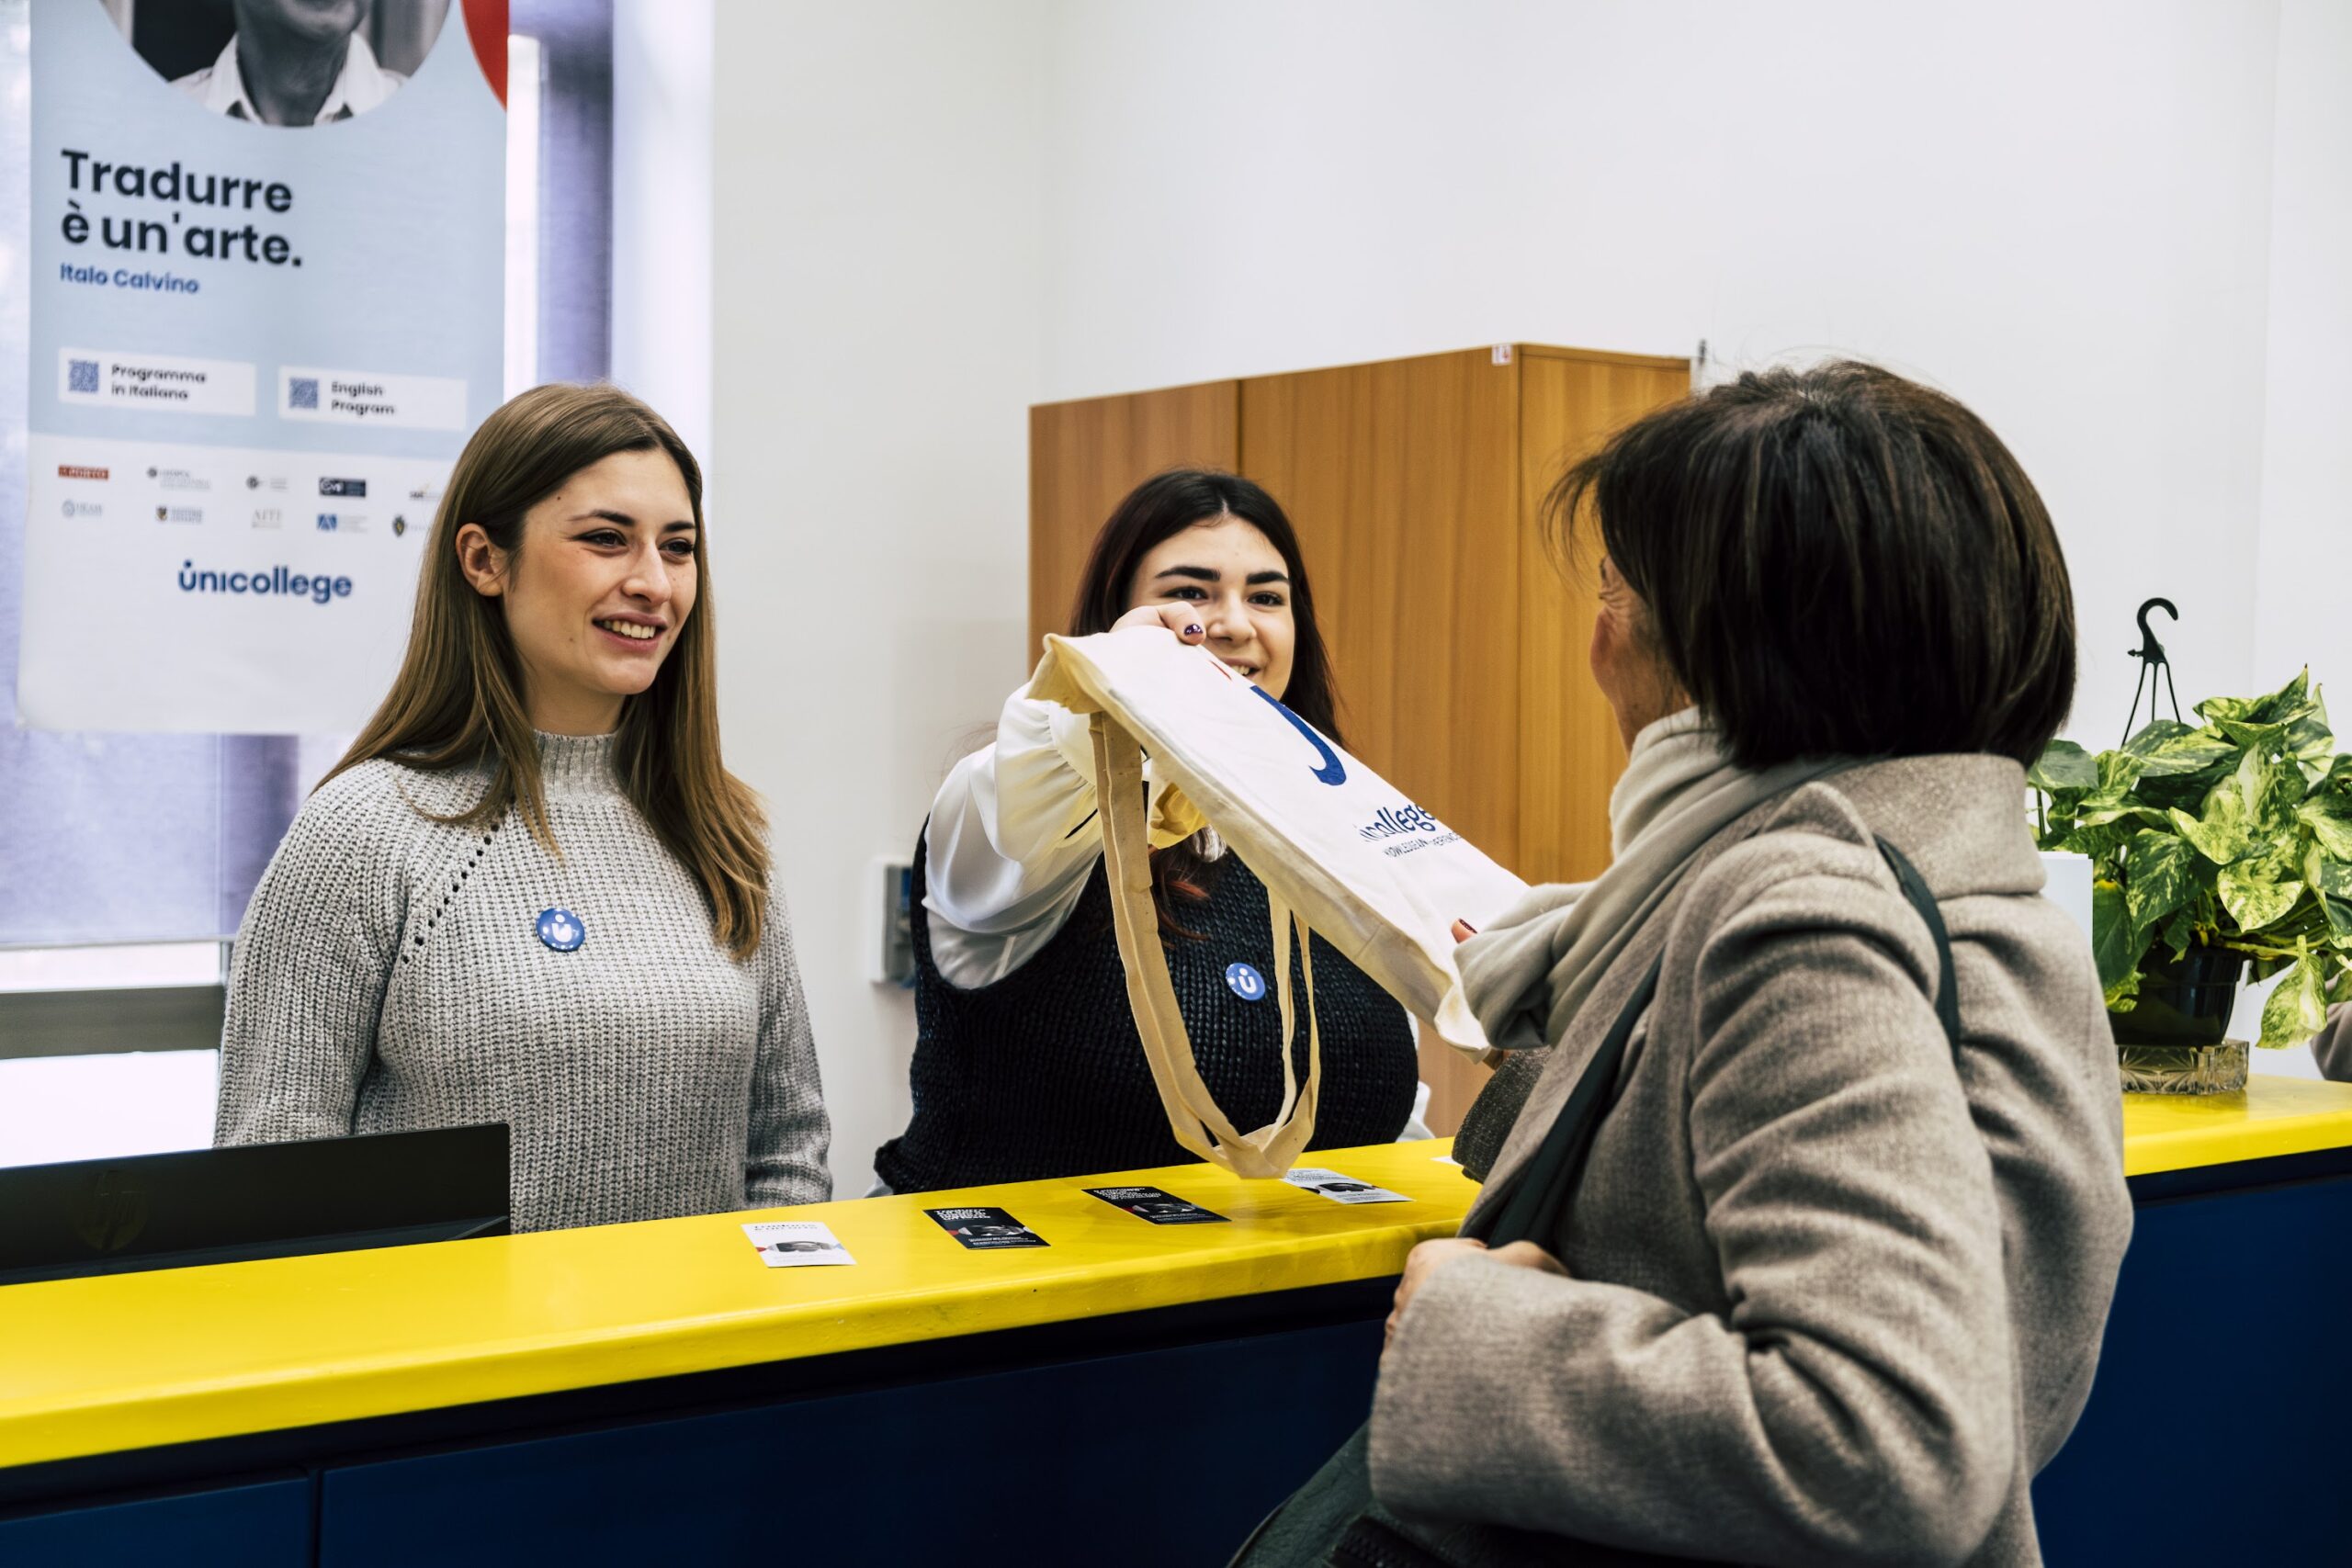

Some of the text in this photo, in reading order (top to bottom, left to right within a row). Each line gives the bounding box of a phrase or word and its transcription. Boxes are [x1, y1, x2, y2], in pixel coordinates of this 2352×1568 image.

[61, 149, 292, 213] Tradurre
[62, 198, 302, 266] è un'arte.
[60, 263, 200, 294] Italo Calvino
[111, 363, 207, 384] Programma
[111, 383, 189, 400] in Italiano
[331, 381, 384, 398] English
[331, 399, 396, 417] Program
